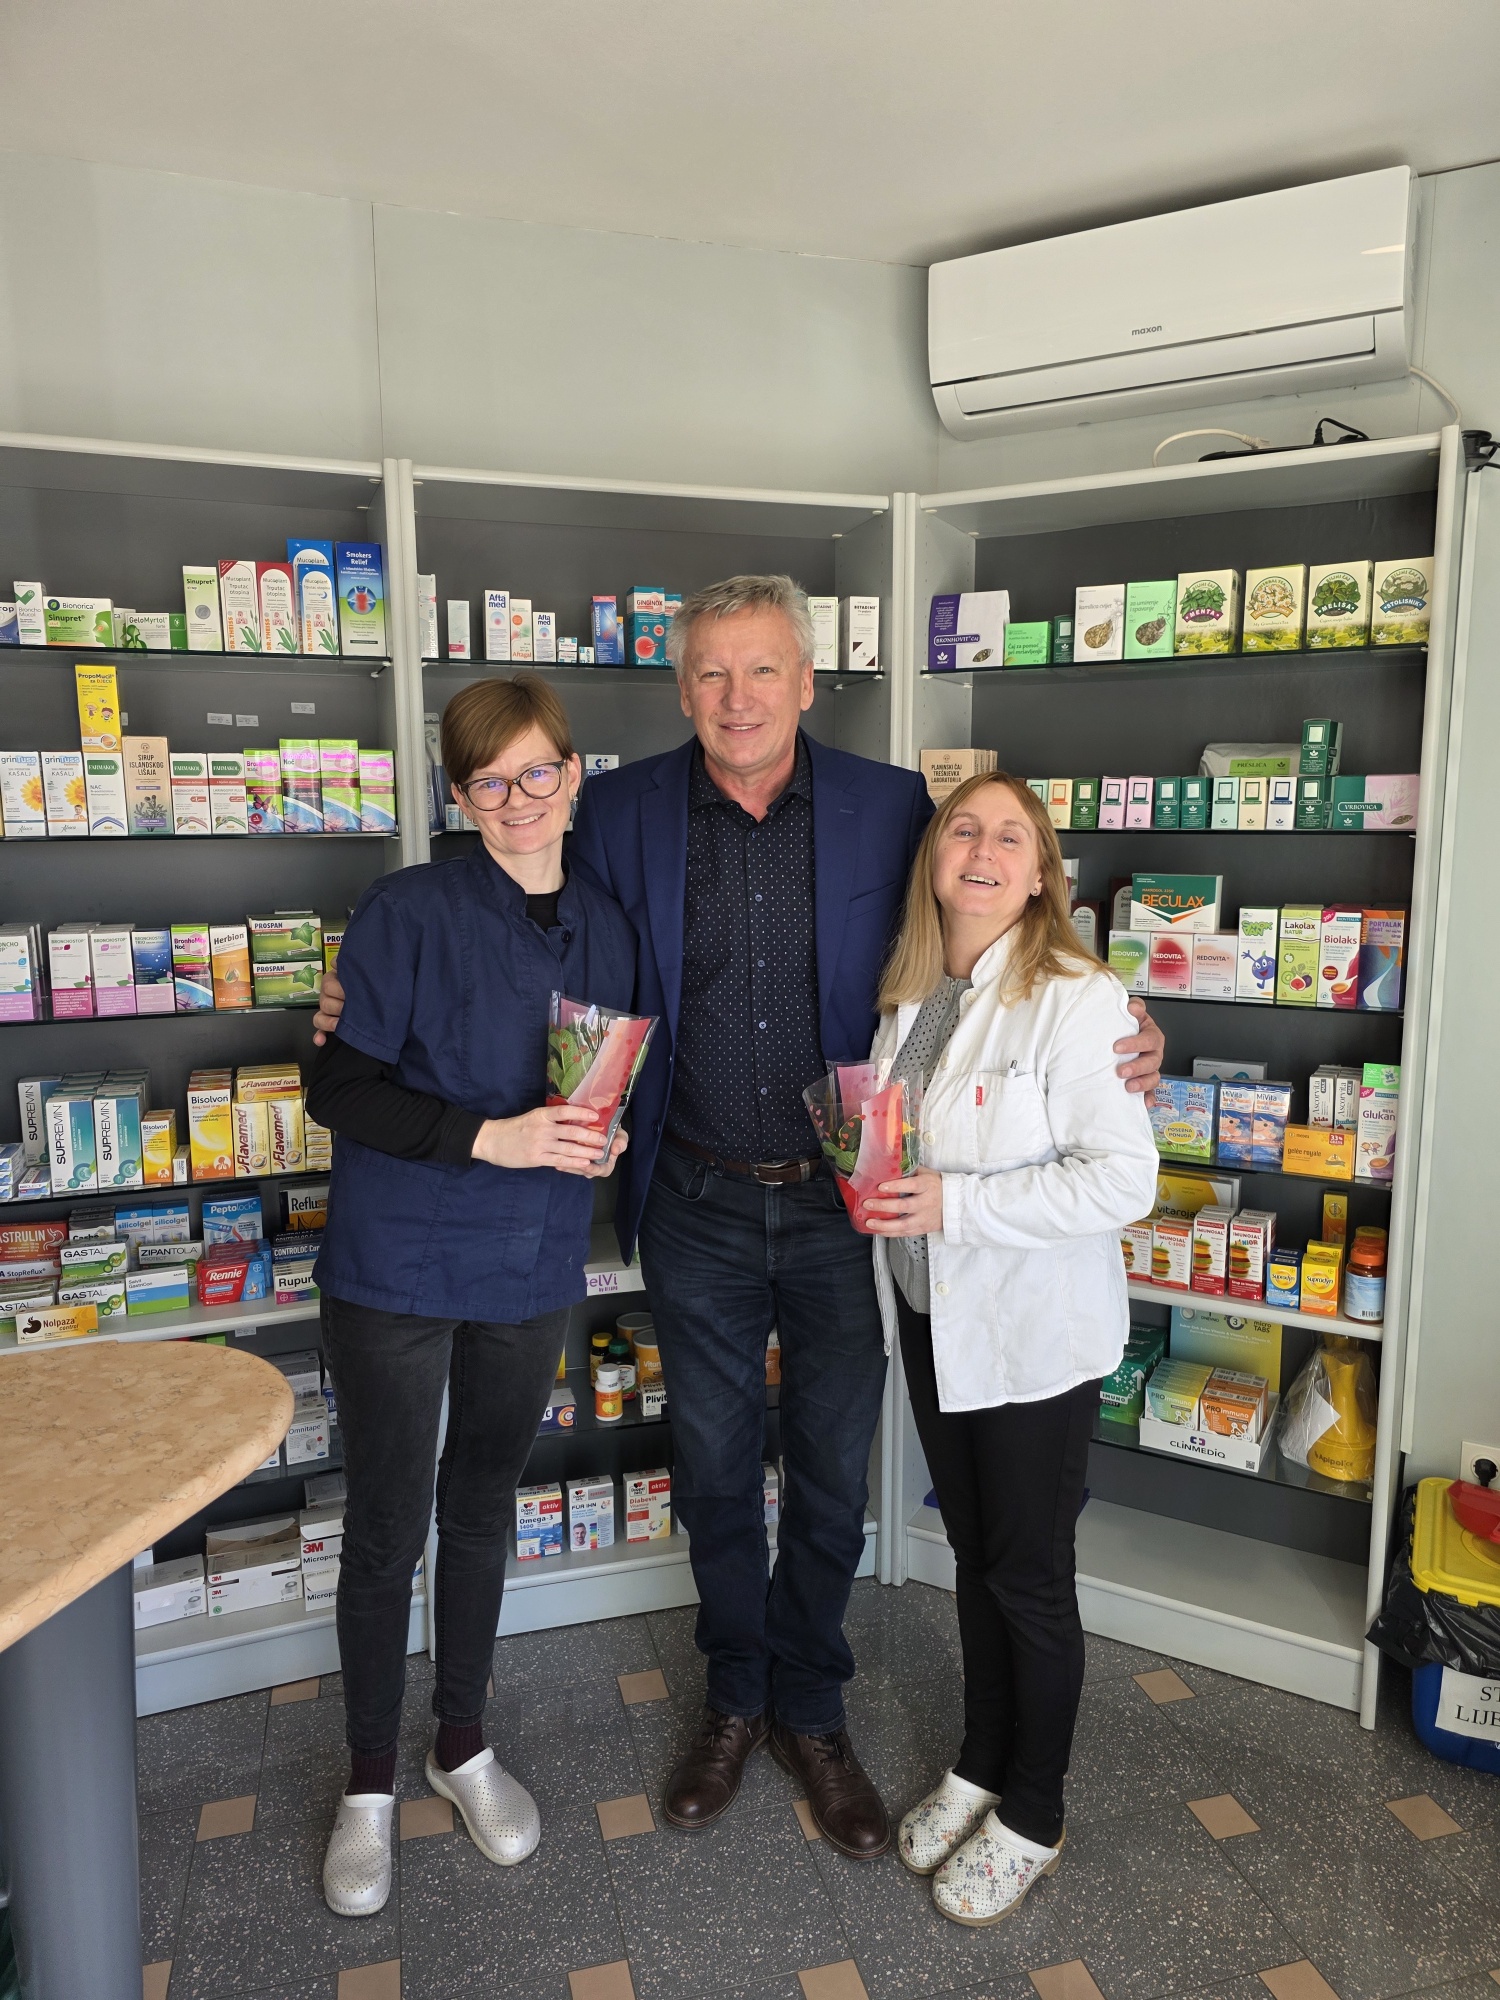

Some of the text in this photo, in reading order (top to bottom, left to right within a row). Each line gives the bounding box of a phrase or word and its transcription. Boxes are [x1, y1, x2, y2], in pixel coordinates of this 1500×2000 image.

[1132, 325, 1162, 336] maxon
[346, 551, 372, 559] Smokers
[62, 602, 95, 610] Bionorica
[1321, 603, 1352, 613] MELISA
[1386, 598, 1420, 610] STOLISNIK
[1189, 609, 1216, 618] MENTA
[512, 651, 532, 659] Aftagal
[137, 768, 157, 776] LIŠAJA
[1141, 894, 1205, 908] BECULAX
[254, 922, 283, 930] PROSPAN
[1284, 921, 1316, 930] Lakolax
[214, 932, 245, 945] Herbion
[1324, 935, 1357, 944] Biolaks
[243, 1079, 282, 1088] Flavamed
[191, 1095, 229, 1104] Bisolvon
[1188, 1092, 1205, 1100] Beta
[1256, 1093, 1278, 1101] MiVita
[1338, 1083, 1347, 1117] Ascorvita
[1184, 1099, 1208, 1109] glucan
[25, 1084, 37, 1141] SUPREMIN
[1362, 1110, 1396, 1121] Glukan
[53, 1104, 66, 1165] SUPREMIN
[100, 1101, 112, 1161] SUPREMIN
[271, 1104, 286, 1164] Flavamed
[235, 1106, 250, 1168] Flavamed
[1303, 1149, 1321, 1157] royale
[211, 1202, 254, 1214] Peptolock
[292, 1196, 318, 1211] Reflu
[118, 1220, 152, 1230] silicolgel
[154, 1216, 188, 1226] silicolgel
[64, 1247, 107, 1258] GASTAL
[141, 1247, 198, 1257] ZIPANTOLA
[274, 1246, 307, 1257] CONTROLOC
[210, 1269, 242, 1281] Rennie
[1272, 1274, 1295, 1282] Supradyn
[586, 1273, 618, 1288] elVi
[1306, 1276, 1333, 1285] Supradyn
[62, 1290, 107, 1301] GASTAL
[43, 1318, 75, 1328] Nolpaza
[1253, 1320, 1272, 1328] micro
[1102, 1393, 1126, 1402] IMUNO
[1151, 1391, 1192, 1407] PROimmuno
[1206, 1404, 1249, 1419] PROimmuno
[289, 1423, 322, 1435] Omnitape
[651, 1482, 667, 1490] aktiv
[519, 1515, 554, 1524] Omega-3
[303, 1542, 324, 1554] 3M
[211, 1588, 222, 1596] 3M
